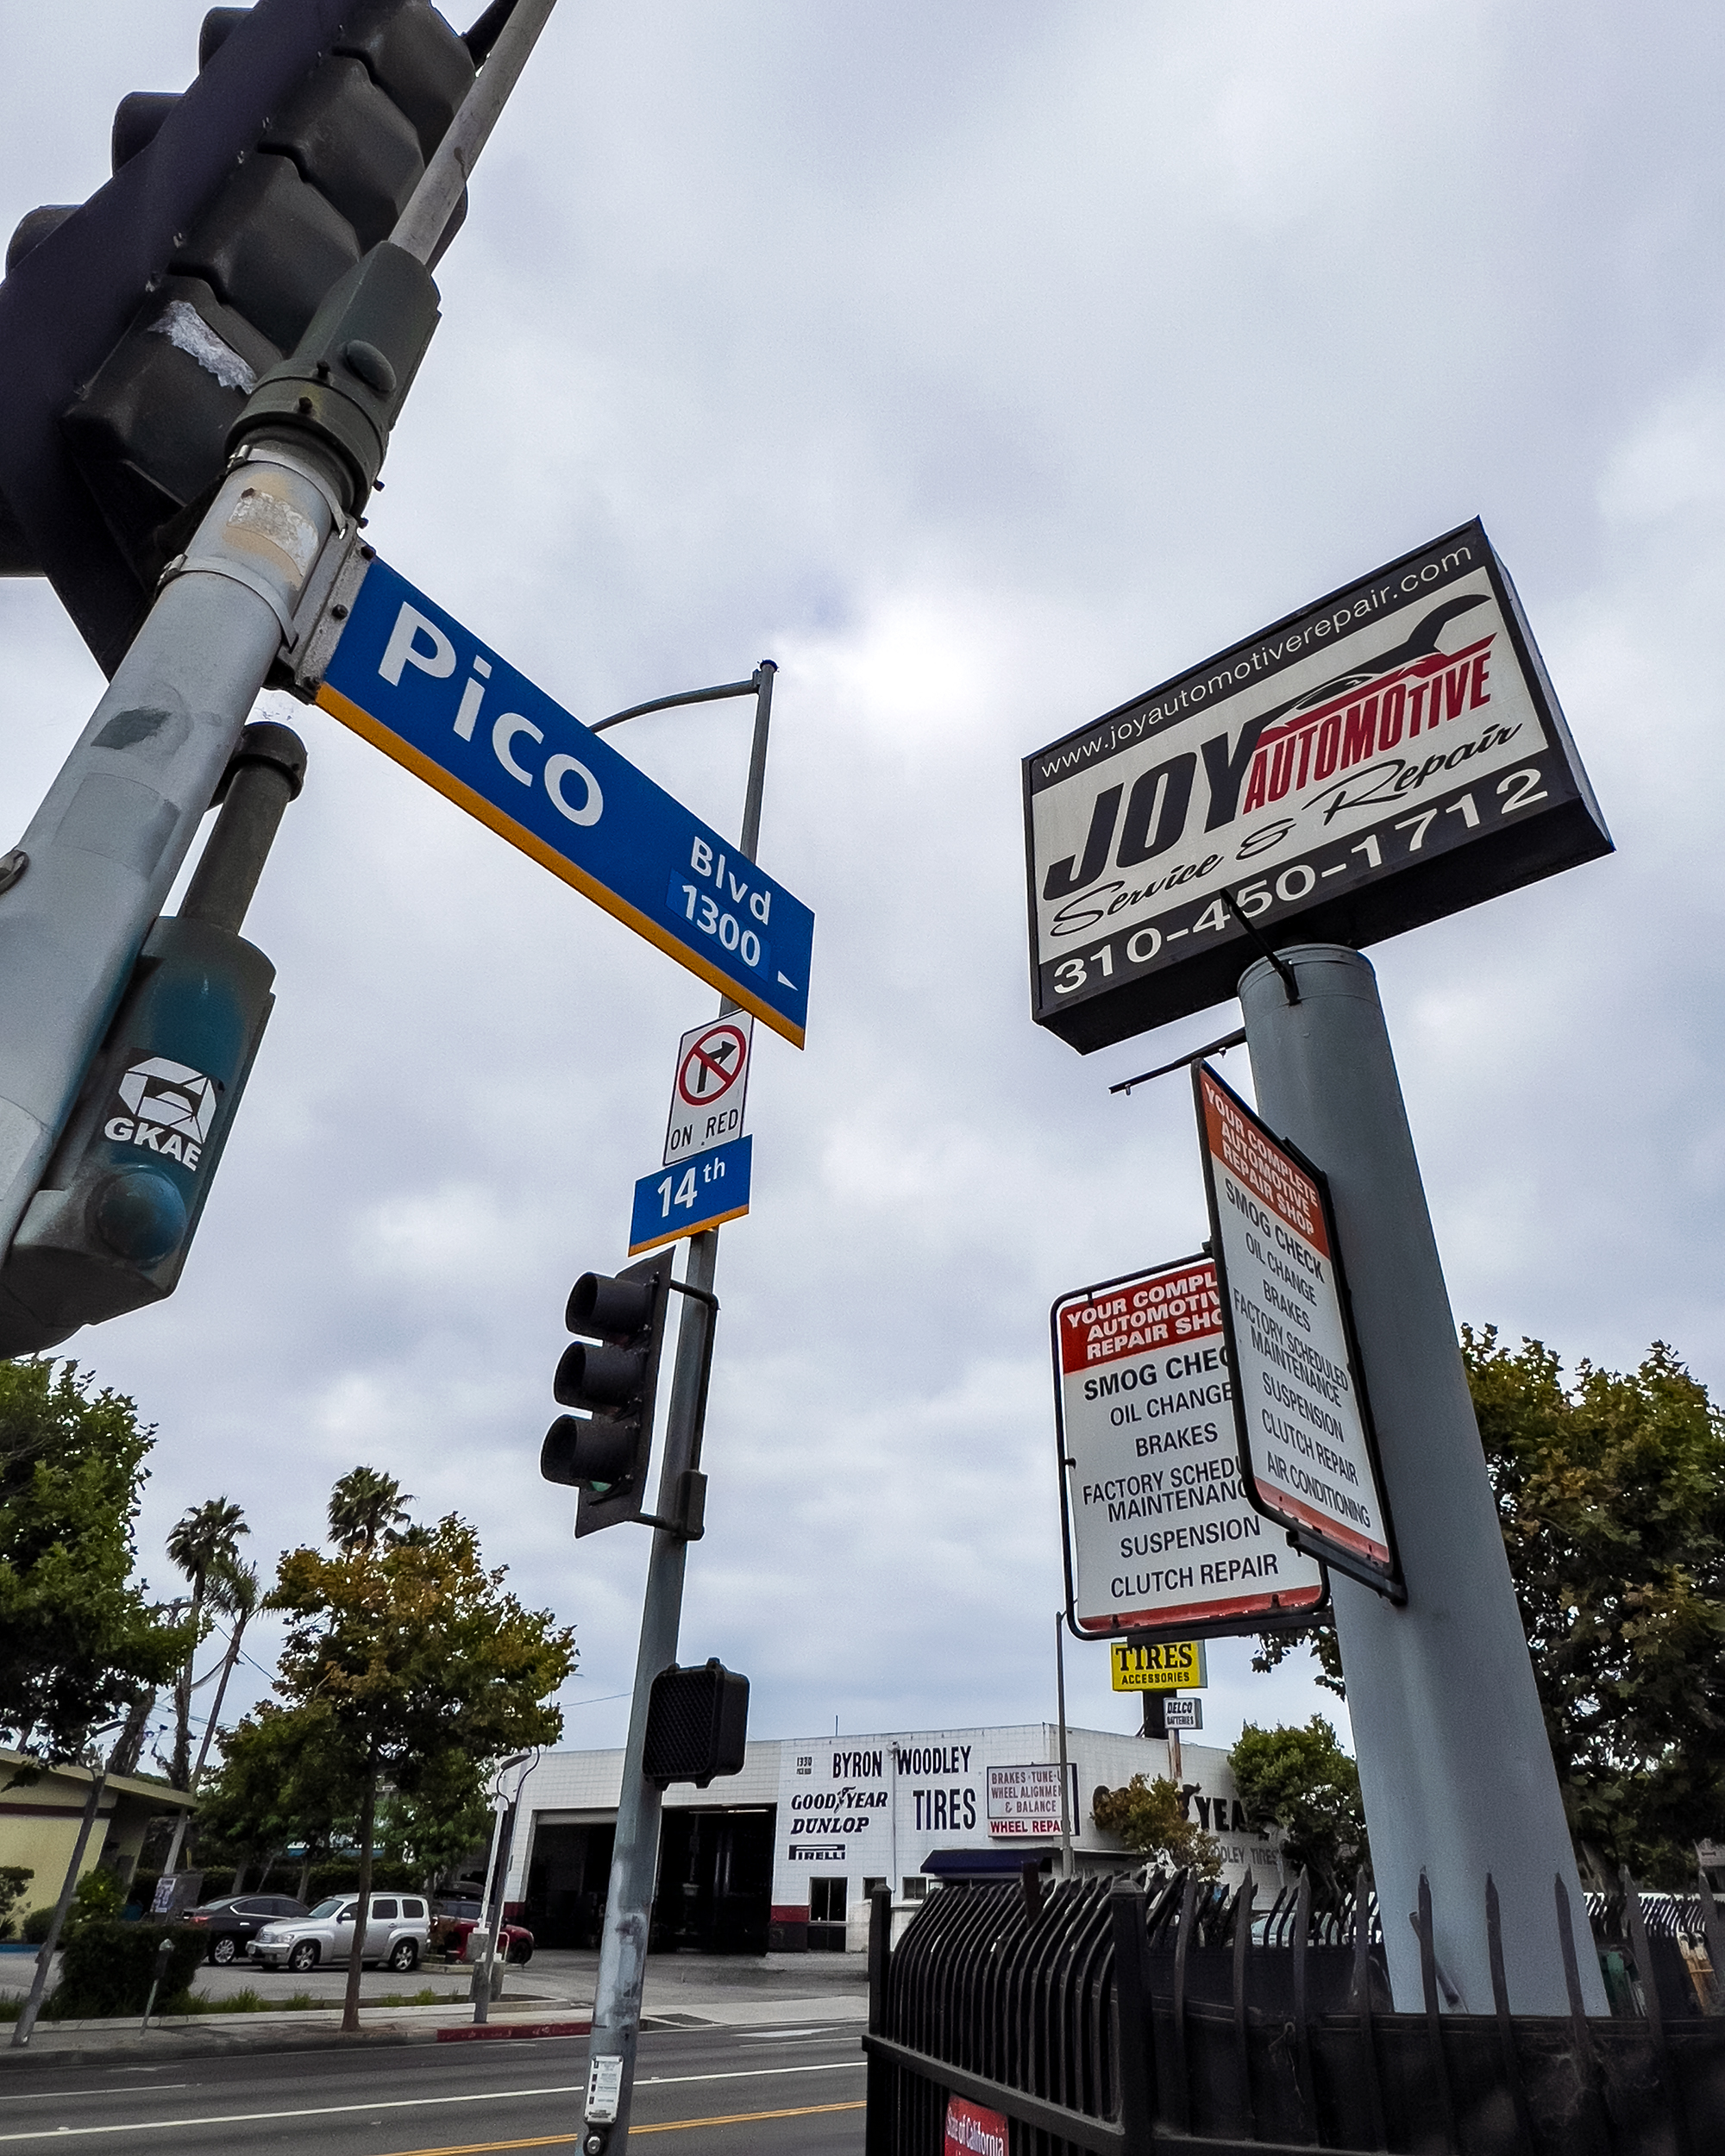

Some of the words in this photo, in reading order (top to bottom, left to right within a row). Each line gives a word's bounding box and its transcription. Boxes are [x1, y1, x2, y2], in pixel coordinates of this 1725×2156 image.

[1040, 544, 1471, 778] www.joyautomotiverepair.com
[378, 601, 604, 826] Pico
[1243, 651, 1491, 815] AUTOMOTIVE
[1043, 719, 1266, 901] JOY
[1050, 854, 1224, 937] Service
[1236, 818, 1296, 861] &
[1301, 723, 1523, 825] Repair
[691, 836, 771, 925] Blvd
[1053, 768, 1548, 993] 310-450-1712
[682, 885, 760, 967] 1300
[104, 1117, 202, 1171] GKAE
[670, 1125, 693, 1150] ON
[706, 1109, 738, 1139] RED
[1204, 1081, 1244, 1137] YOUR
[1247, 1130, 1318, 1207] COMPLETE
[657, 1157, 725, 1218] 14th
[1221, 1121, 1311, 1218] AUTOMOTIVE
[1222, 1139, 1274, 1203] REPAIR
[1276, 1193, 1314, 1236] SHOP
[1225, 1178, 1271, 1238] SMOG
[1275, 1224, 1325, 1283] CHECK
[1245, 1232, 1265, 1265] OIL
[1267, 1250, 1317, 1307] CHANGE
[1067, 1297, 1126, 1327] YOUR
[1133, 1272, 1218, 1308] COMPL
[1087, 1289, 1220, 1342] AUTOMOTIV
[1263, 1279, 1311, 1332] BRAKES
[1087, 1324, 1168, 1360] REPAIR
[1176, 1307, 1223, 1335] SHO
[1233, 1288, 1283, 1345] FACTORY
[1287, 1331, 1348, 1391] SCHEDULED
[1084, 1363, 1157, 1401] SMOG
[1166, 1346, 1229, 1379] CHEC
[1251, 1325, 1341, 1407] MAINTENANCE
[1110, 1403, 1142, 1426] OIL
[1146, 1382, 1233, 1418] CHANGE
[1263, 1371, 1344, 1443] SUSPENSION
[1135, 1422, 1218, 1457] BRAKES
[1262, 1408, 1314, 1460] CLUTCH
[1315, 1441, 1358, 1487] REPAIR
[1083, 1470, 1164, 1505] FACTORY
[1108, 1478, 1248, 1522] MAINTENANC
[1267, 1451, 1289, 1484] AIR
[1290, 1464, 1371, 1528] CONDITIONING
[1120, 1514, 1261, 1558] SUSPENSION
[1111, 1566, 1193, 1598] CLUTCH
[1201, 1553, 1278, 1585] REPAIR
[1115, 1643, 1193, 1671] TIRES
[1121, 1671, 1190, 1685] ACCESSORIES
[1167, 1702, 1193, 1714] DELCO
[832, 1750, 883, 1778] BYRON
[897, 1745, 971, 1775] WOODLEY
[991, 1771, 1026, 1784] BRAKES
[913, 1788, 976, 1830] TIRES
[991, 1787, 1019, 1799] WHEEL
[1016, 1800, 1057, 1813] BALANCE
[788, 1844, 845, 1860] PIRELLI
[790, 1817, 869, 1834] DUNLOP
[990, 1821, 1028, 1833] WHEEL
[1032, 1820, 1071, 1833] REPA
[1250, 1847, 1280, 1865] TIRES
